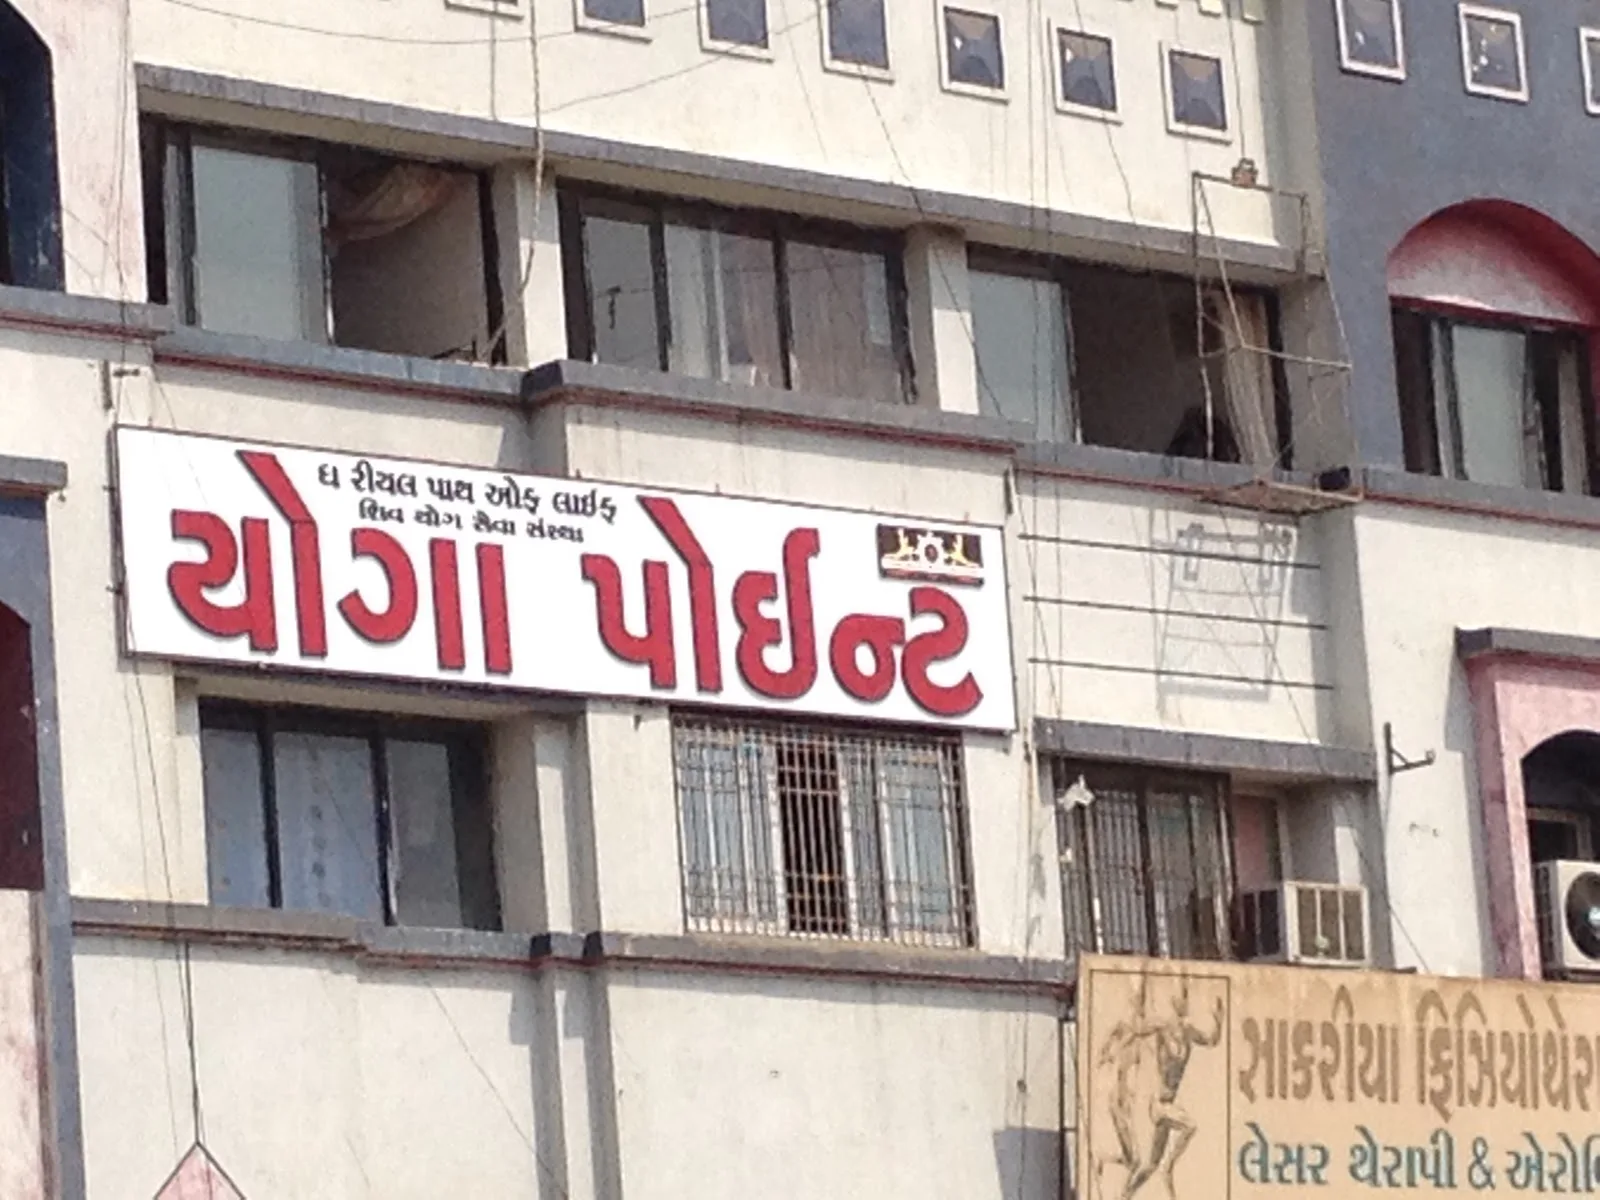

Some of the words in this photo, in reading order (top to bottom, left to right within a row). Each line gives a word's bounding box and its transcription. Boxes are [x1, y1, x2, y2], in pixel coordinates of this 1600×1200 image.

[426, 477, 475, 504] પાથ
[166, 449, 513, 675] યોગા
[1239, 984, 1400, 1104] સાકરીયા
[1238, 1121, 1330, 1186] લેસર
[1348, 1124, 1457, 1190] થેરાપી
[1467, 1136, 1496, 1191] &
